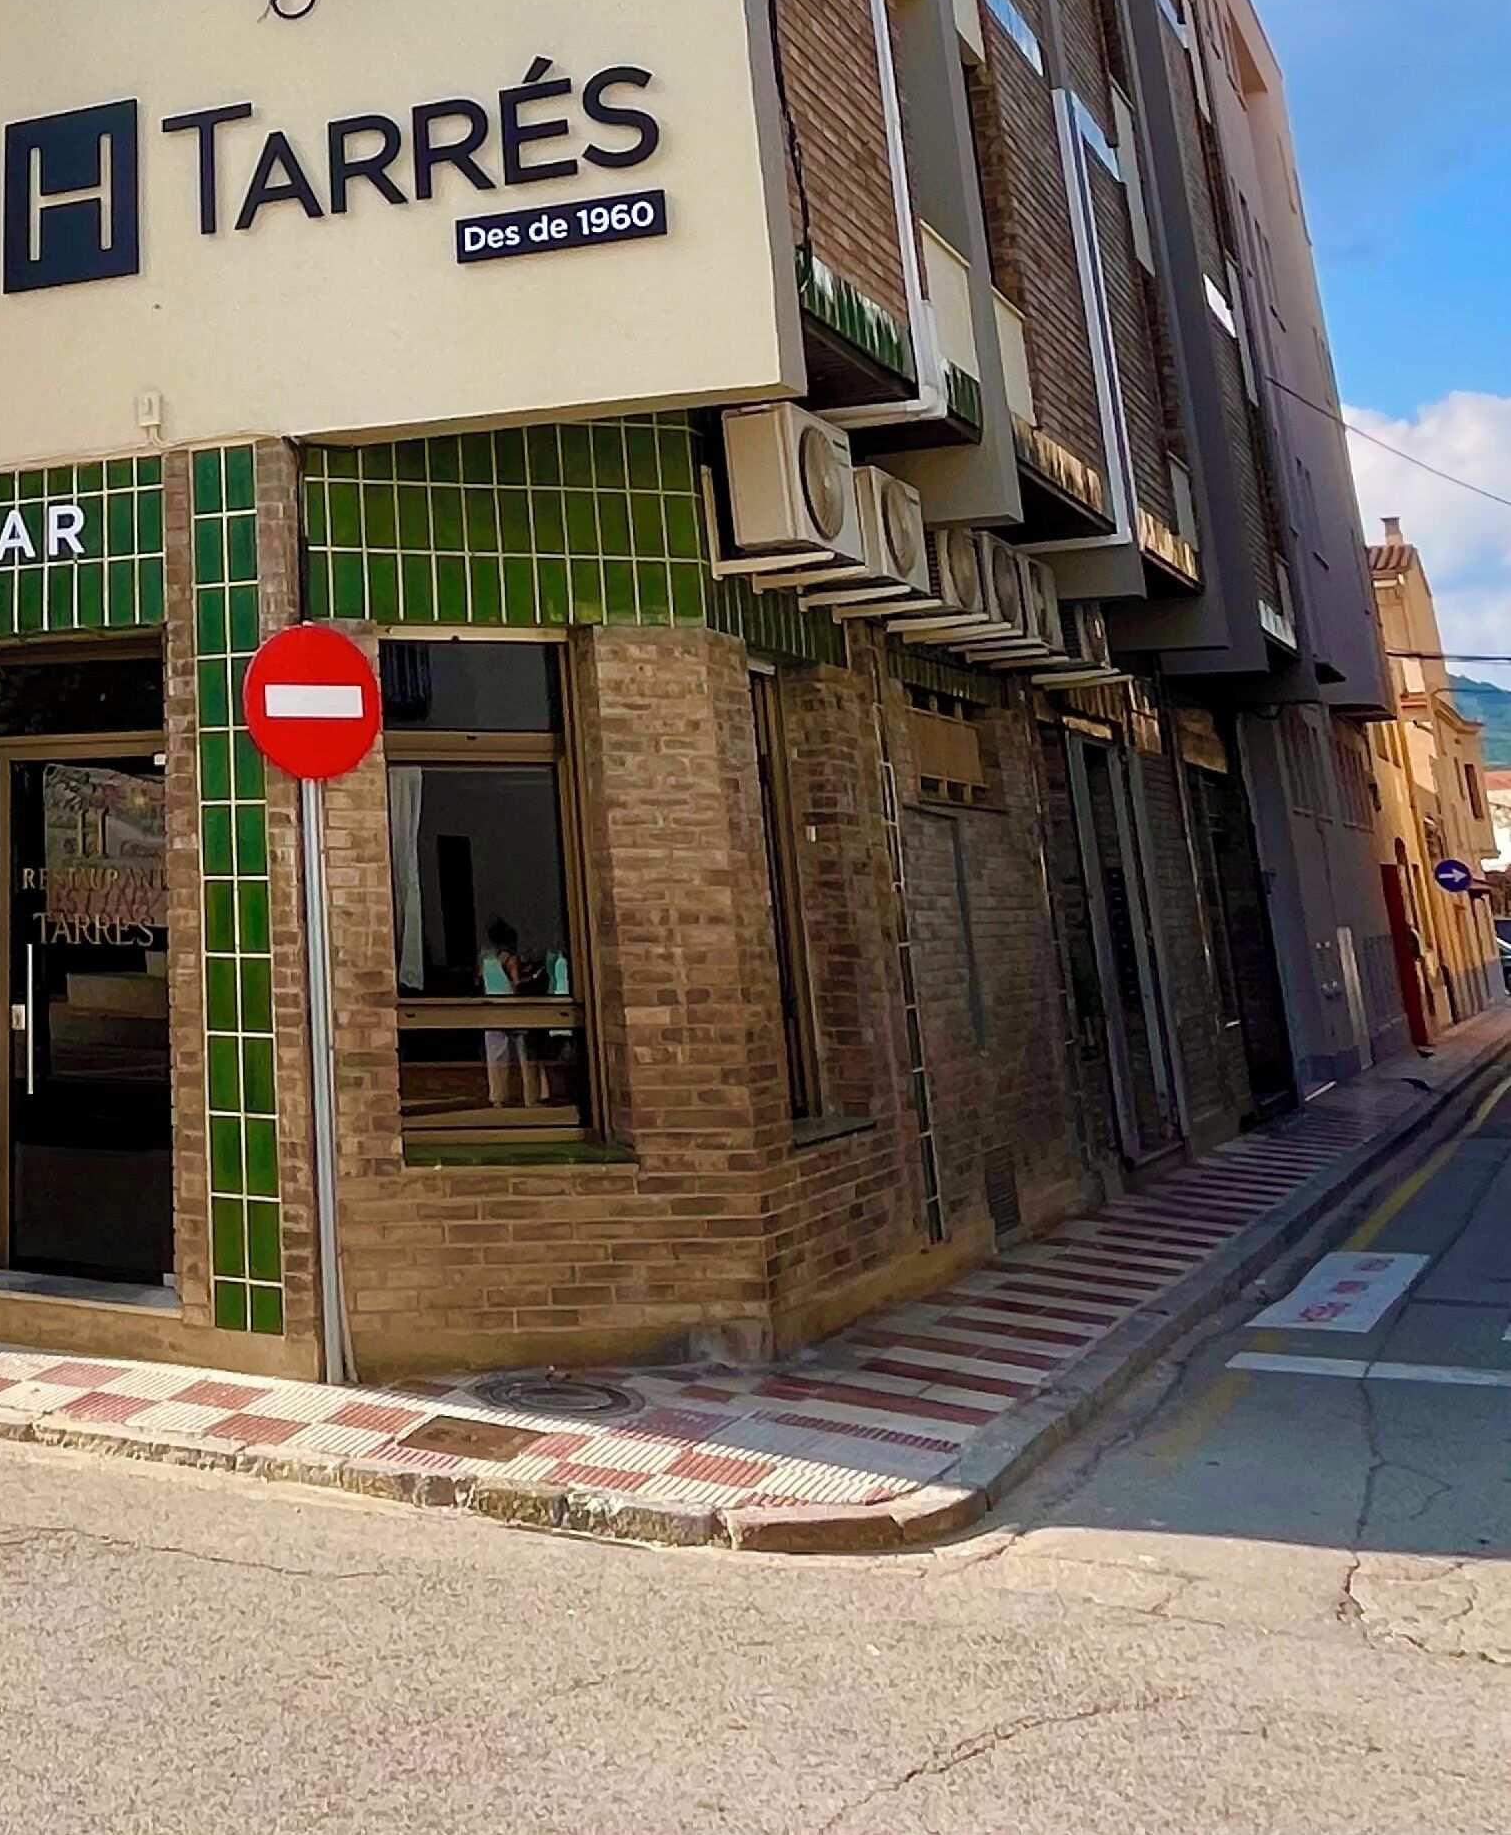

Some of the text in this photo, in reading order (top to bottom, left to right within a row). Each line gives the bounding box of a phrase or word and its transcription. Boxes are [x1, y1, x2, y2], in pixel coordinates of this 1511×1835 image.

[29, 56, 660, 263] H TARRÉS
[464, 201, 654, 253] Des de 1960
